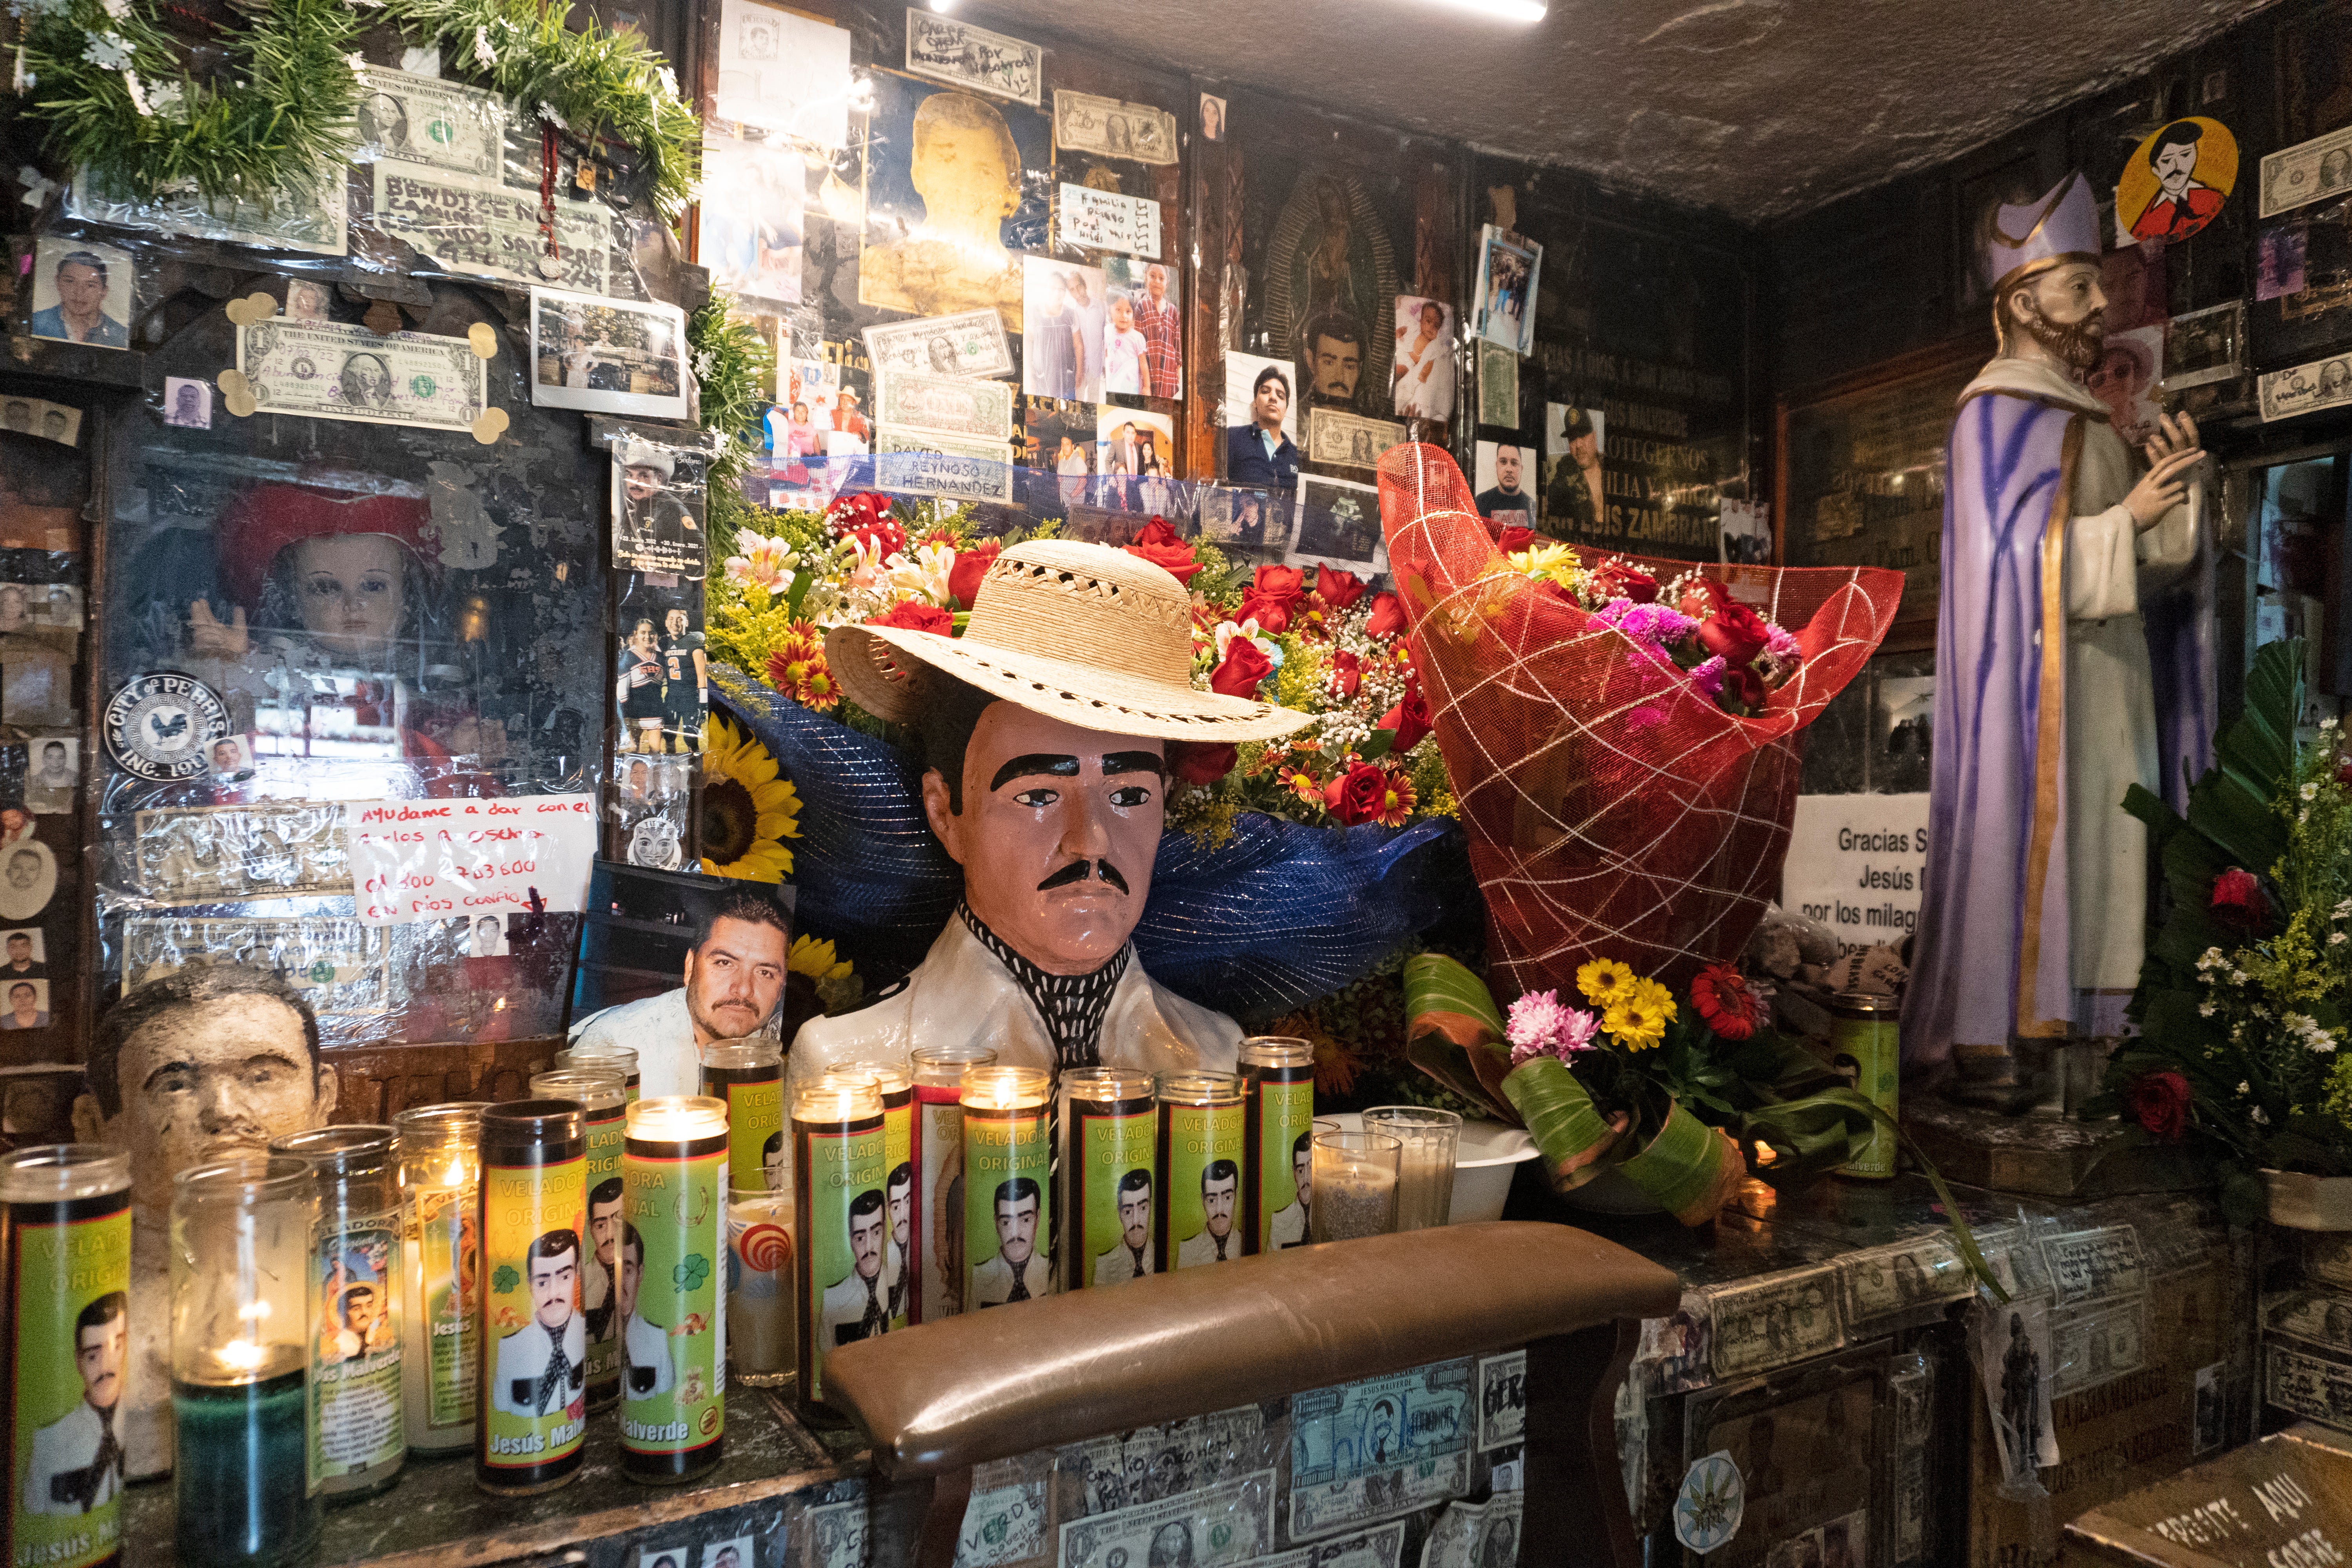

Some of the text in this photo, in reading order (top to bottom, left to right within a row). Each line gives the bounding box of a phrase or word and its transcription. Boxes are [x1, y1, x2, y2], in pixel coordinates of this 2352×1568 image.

[283, 330, 445, 356] THE UNITED STATES OF AMERICA
[320, 405, 412, 420] ONE DOLLAR
[894, 444, 942, 460] DAVID
[1608, 436, 1708, 471] OTEGERNOS
[912, 461, 980, 477] REYNOSO
[903, 476, 1003, 497] HERNANDEZ
[1628, 508, 1721, 546] ZAMBRAN
[668, 656, 681, 680] 2
[108, 687, 141, 726] CITY
[163, 678, 225, 732] PERRIS
[120, 749, 161, 777] INC.
[465, 806, 479, 814] a
[488, 802, 521, 815] dar
[537, 803, 568, 813] con
[573, 802, 590, 813] el
[1838, 827, 1927, 853] Gracias S
[1859, 864, 1914, 891] Jesús
[1836, 900, 1861, 925] los
[628, 1170, 666, 1189] ORA
[1361, 1379, 1412, 1396] JESUS MALVERDE
[490, 1432, 545, 1455] Jesús
[2250, 1472, 2313, 1529] AQUI
